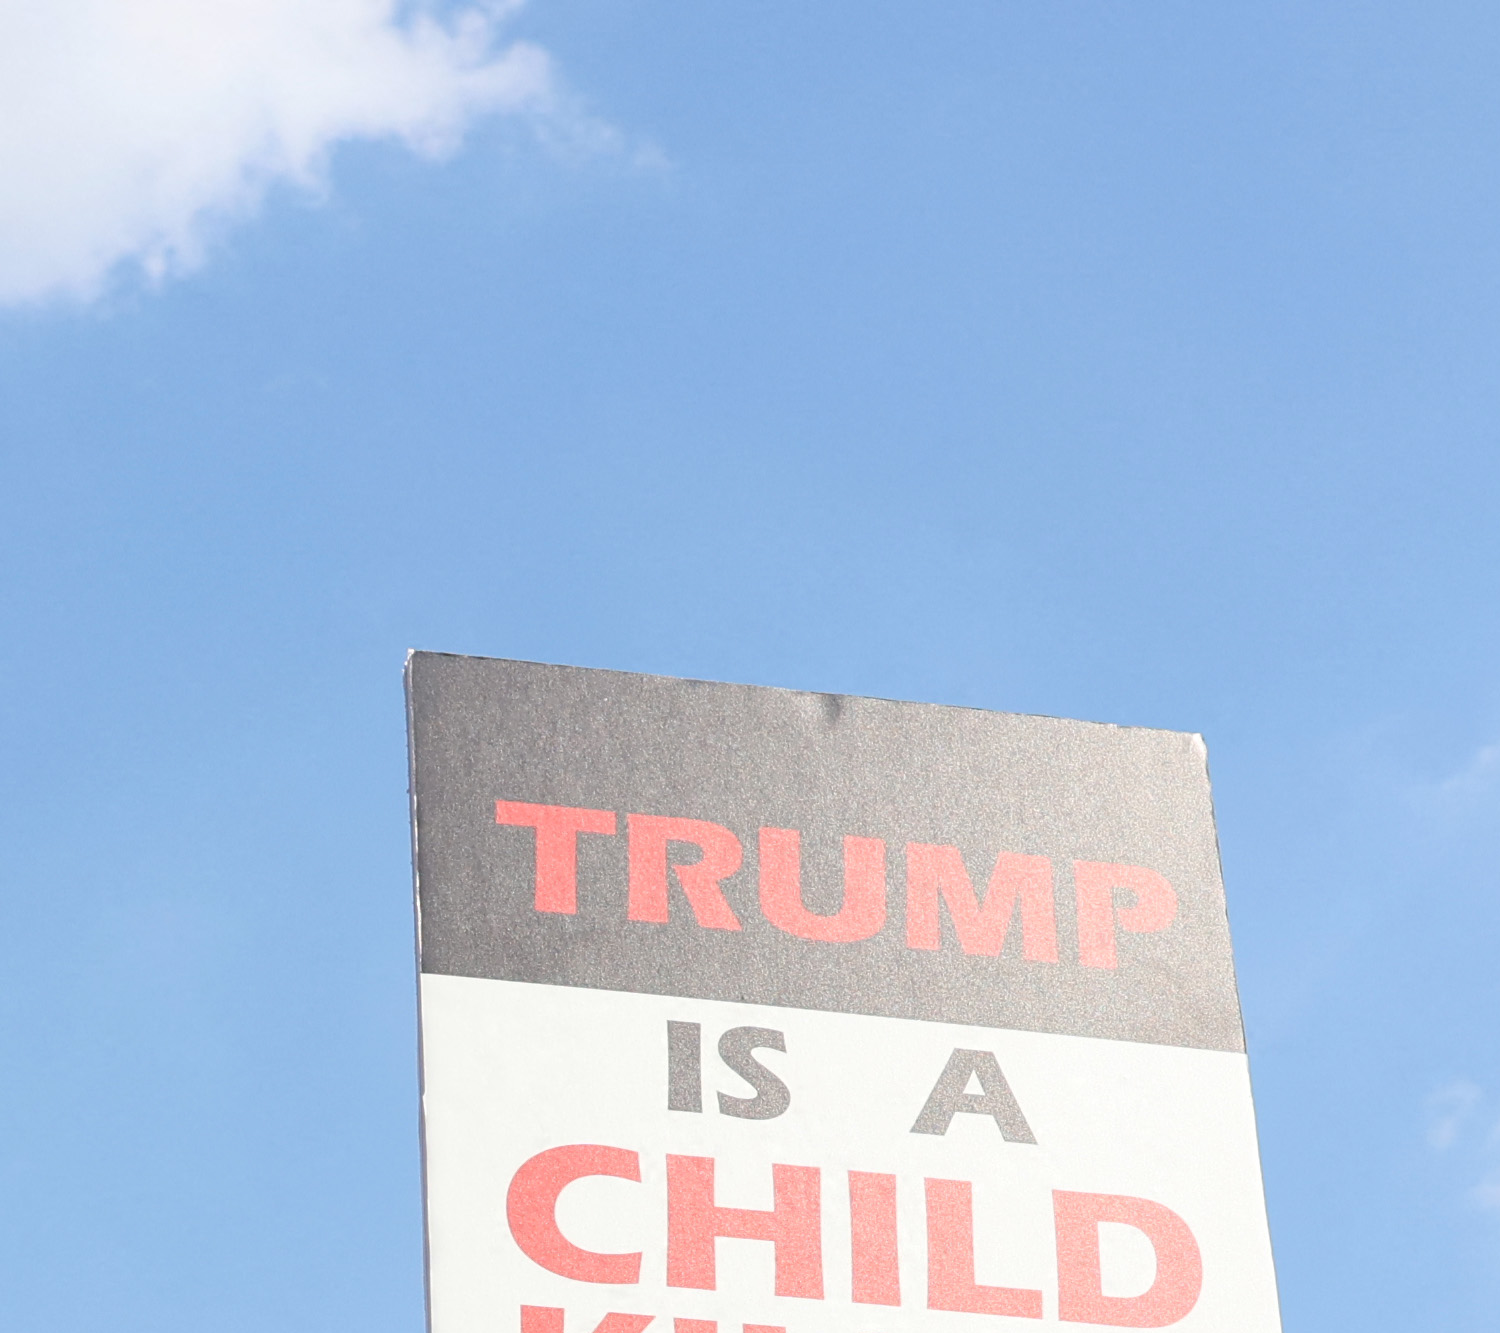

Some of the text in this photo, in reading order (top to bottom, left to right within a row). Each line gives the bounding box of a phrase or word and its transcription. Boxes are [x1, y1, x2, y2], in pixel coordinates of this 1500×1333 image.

[495, 799, 1178, 970] TRUMP
[667, 1020, 1036, 1144] IS A
[507, 1145, 1199, 1325] CHILD
